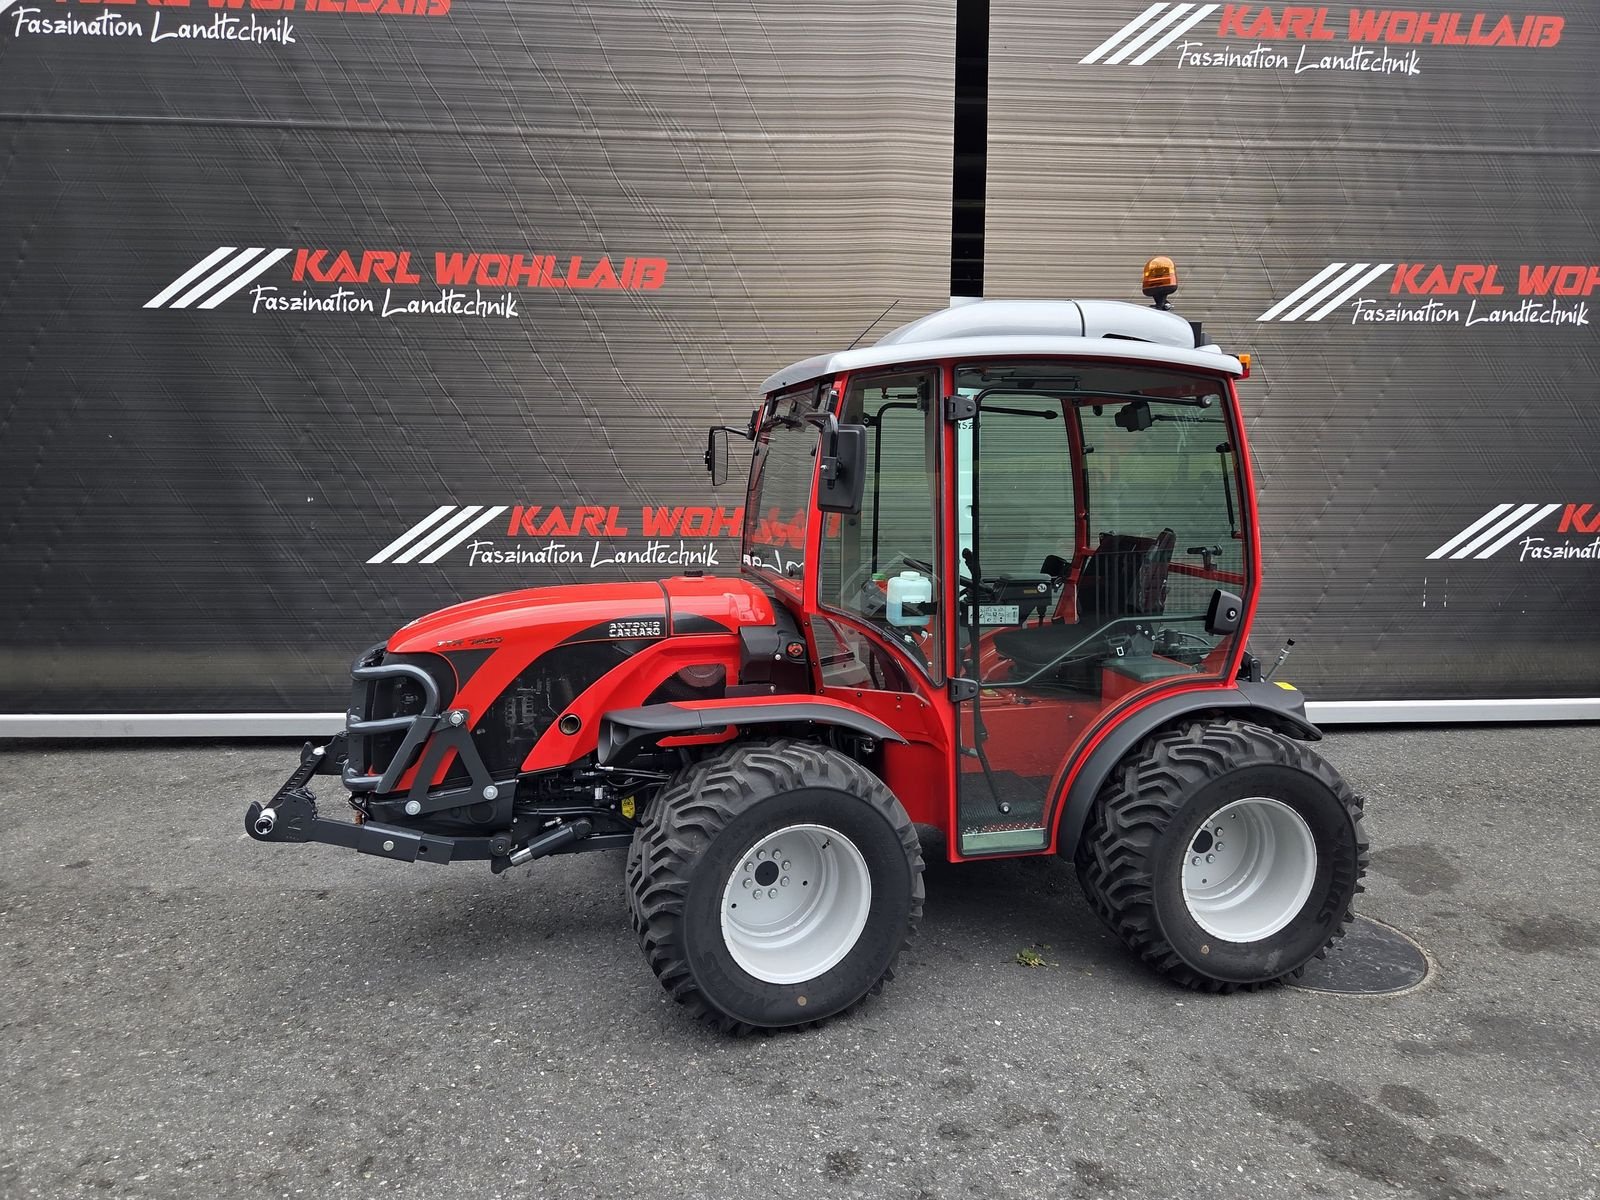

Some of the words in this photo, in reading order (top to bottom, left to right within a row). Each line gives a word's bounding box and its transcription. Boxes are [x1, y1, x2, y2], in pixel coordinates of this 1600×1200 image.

[11, 5, 142, 38] Faszination
[150, 10, 296, 45] Landtechnik
[1217, 4, 1335, 39] KARL
[1176, 42, 1289, 70] Faszination
[1294, 43, 1421, 76] Landtechnik
[291, 248, 421, 284] KARL
[1390, 263, 1505, 296] KARL
[249, 284, 374, 314] Faszination
[381, 287, 519, 319] Landtechnik
[1351, 297, 1460, 325] Faszination
[1464, 298, 1590, 327] Landtechnik
[507, 505, 629, 537] KARL
[466, 539, 584, 567] Faszination
[590, 539, 719, 569] Landtechnik
[609, 627, 661, 638] CARRARO
